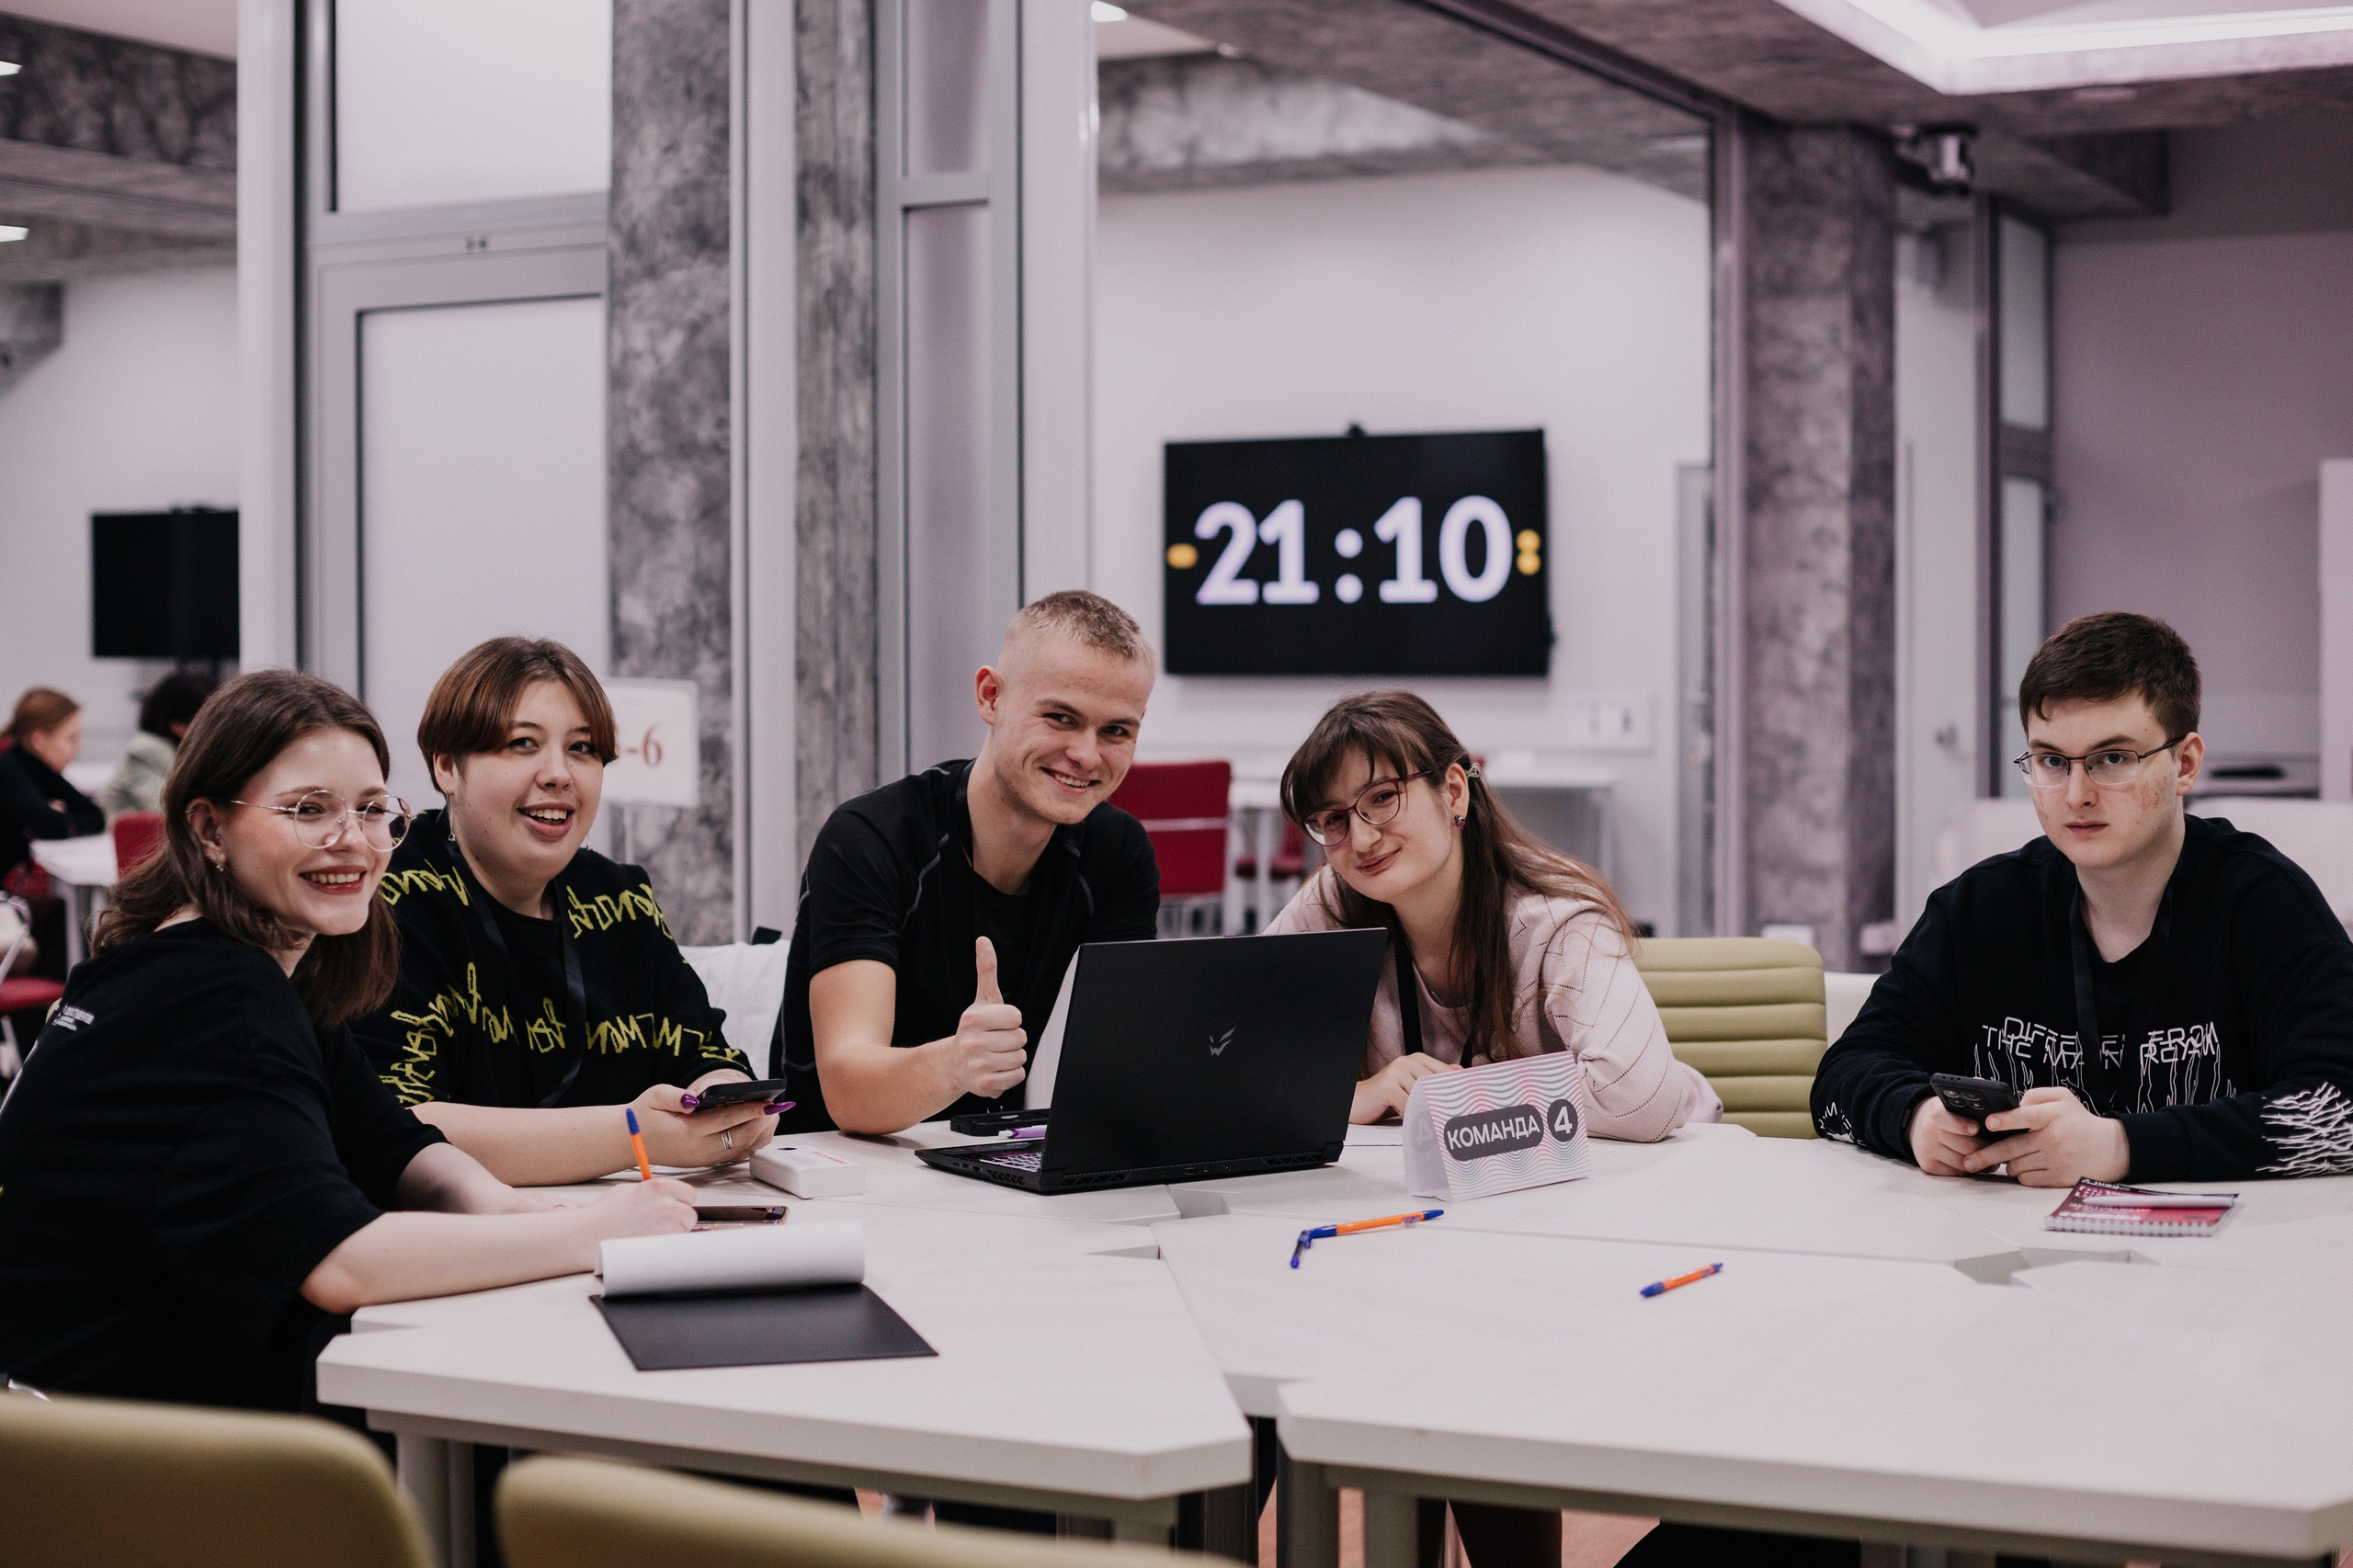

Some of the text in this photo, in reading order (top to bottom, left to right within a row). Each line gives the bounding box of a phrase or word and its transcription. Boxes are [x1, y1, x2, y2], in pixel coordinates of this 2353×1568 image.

[1195, 494, 1513, 605] 21:10
[618, 723, 663, 767] -6
[1447, 1106, 1573, 1150] КОМАНДА 4
